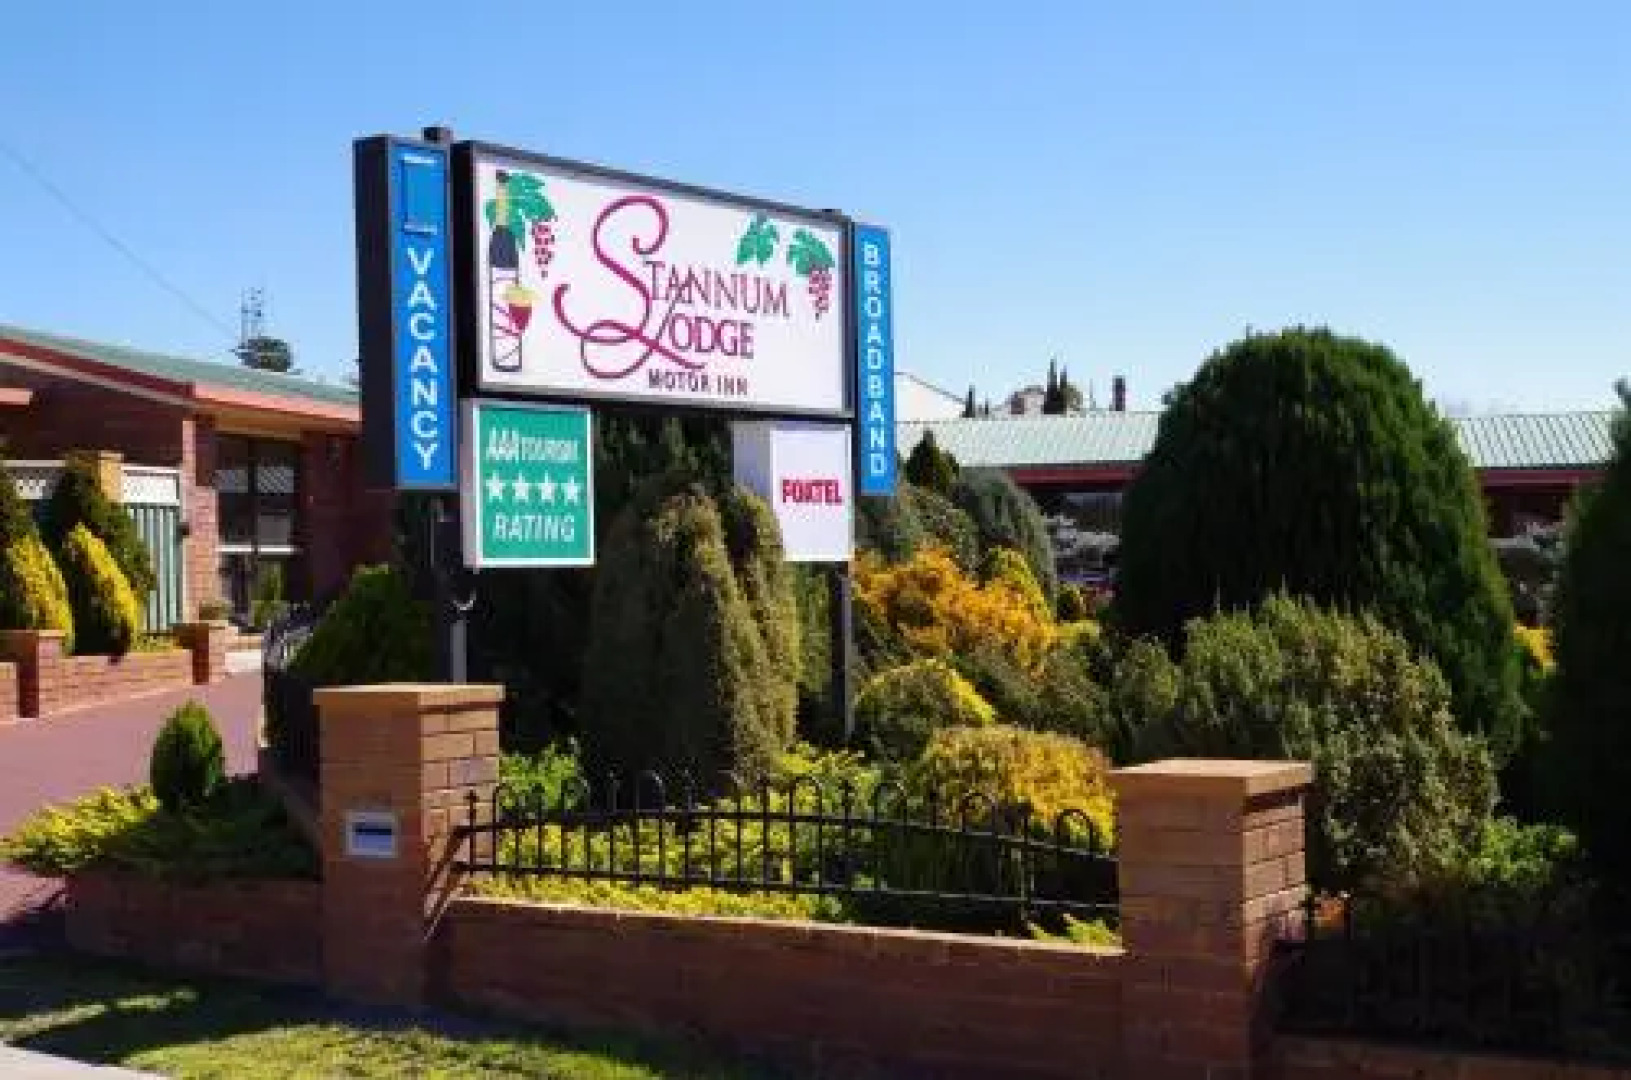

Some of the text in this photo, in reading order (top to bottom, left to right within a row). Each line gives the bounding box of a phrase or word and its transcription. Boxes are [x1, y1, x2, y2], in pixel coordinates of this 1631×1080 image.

[552, 195, 790, 342] STANNUM
[407, 246, 439, 471] VACANCY
[580, 296, 755, 379] LODGE
[863, 244, 887, 477] BROADBAND
[647, 368, 749, 396] MOTOR INN
[492, 511, 576, 543] RATING
[781, 478, 843, 504] FOXTEL
